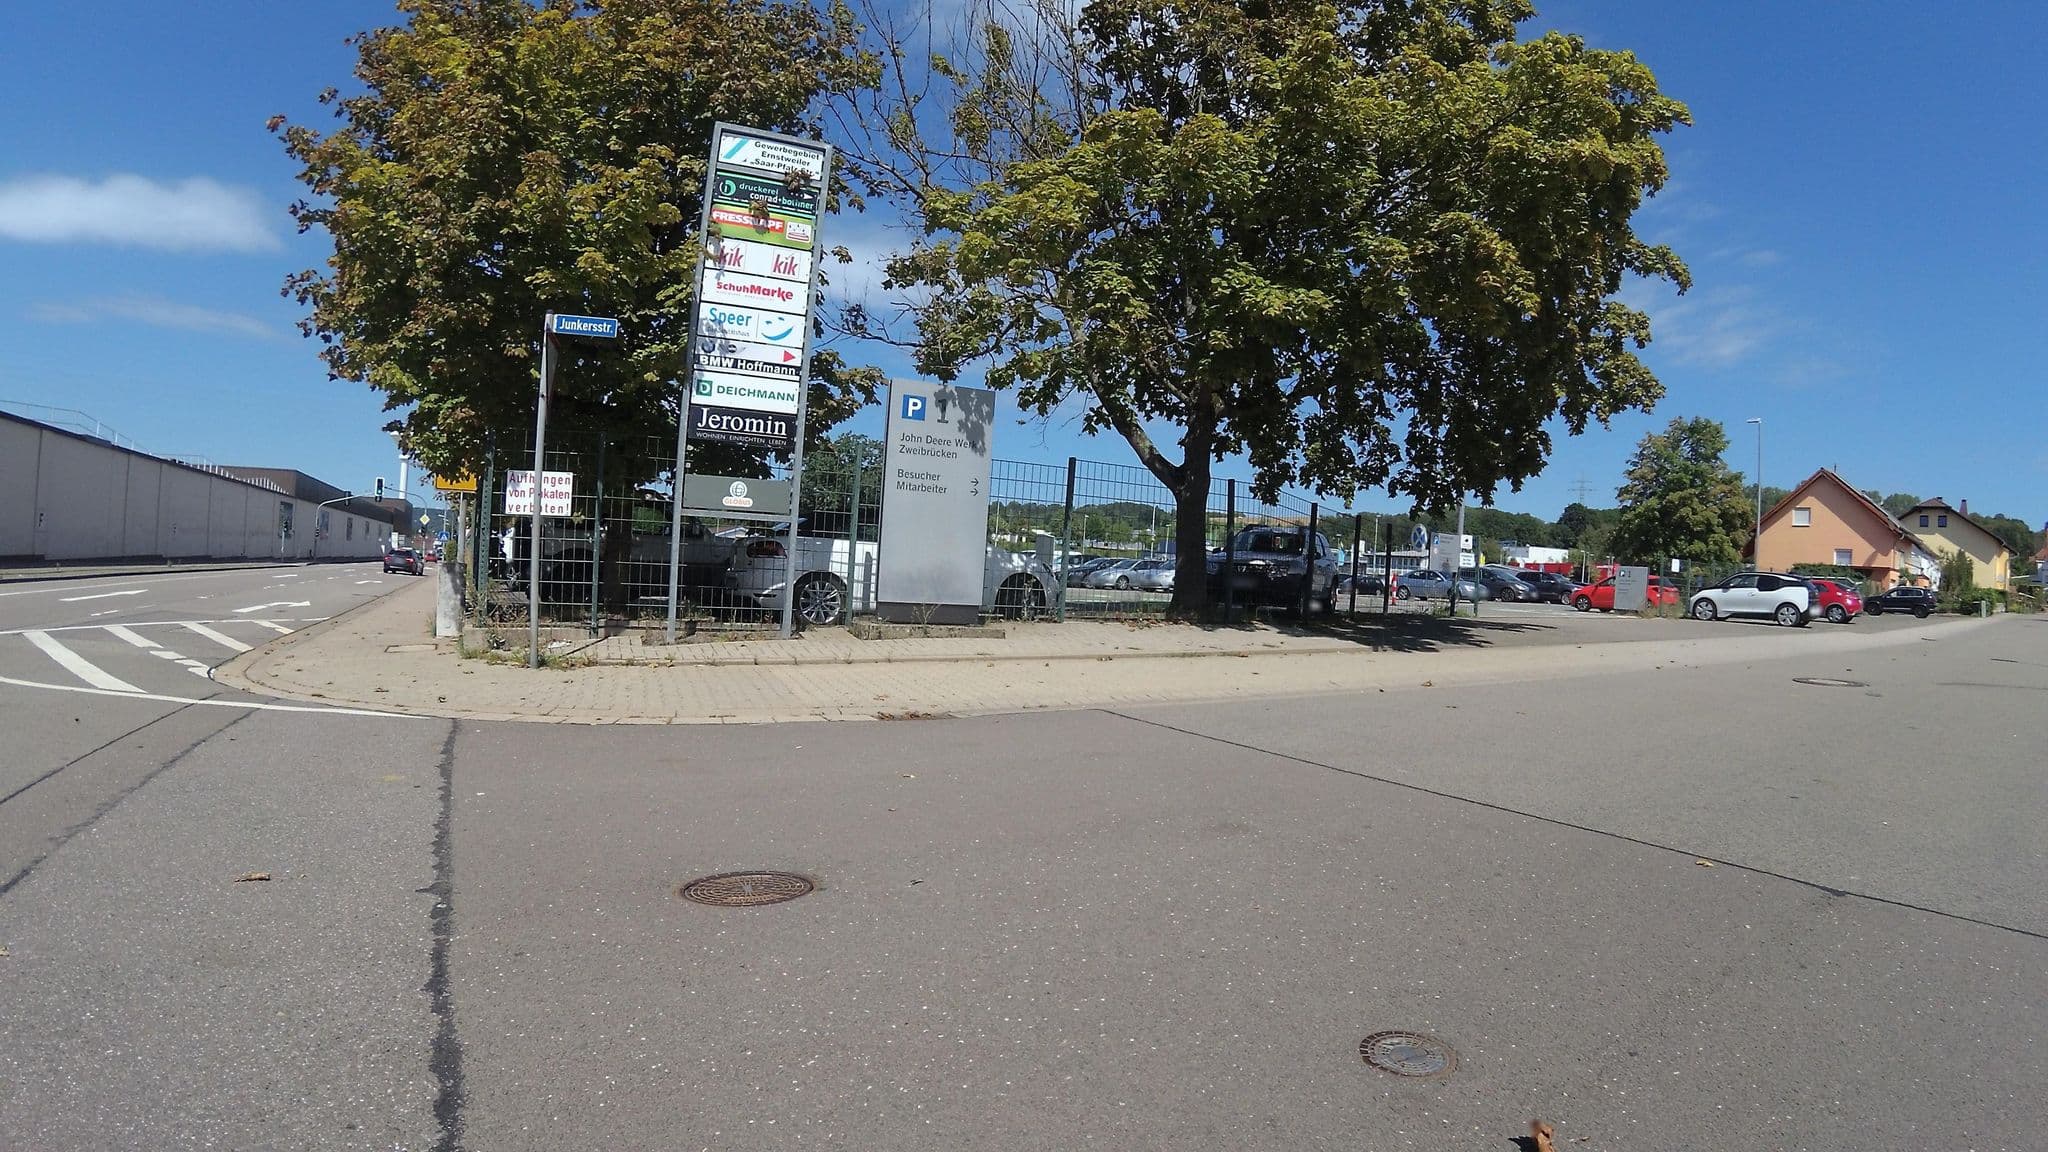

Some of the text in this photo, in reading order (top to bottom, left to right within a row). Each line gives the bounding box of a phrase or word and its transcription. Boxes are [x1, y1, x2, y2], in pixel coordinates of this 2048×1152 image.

[754, 141, 819, 161] Gewerbegebiet
[761, 150, 810, 167] Ernstweiler
[739, 182, 779, 195] druckerei
[719, 245, 799, 277] kik kik
[559, 317, 614, 334] Junkersstr.
[708, 307, 752, 327] Speer
[699, 354, 796, 376] BMW Hoffmann
[716, 385, 795, 402] DEICHMANN
[907, 397, 949, 424] P 1
[697, 407, 788, 436] Jeromin
[900, 432, 978, 449] John Deere Werk
[899, 444, 958, 459] Zweibrücken
[509, 471, 571, 488] Aufhngen
[897, 468, 941, 481] Besucher
[508, 487, 570, 500] von Pkaten
[896, 481, 947, 494] Mitarbeiter
[508, 501, 570, 515] verbten!
